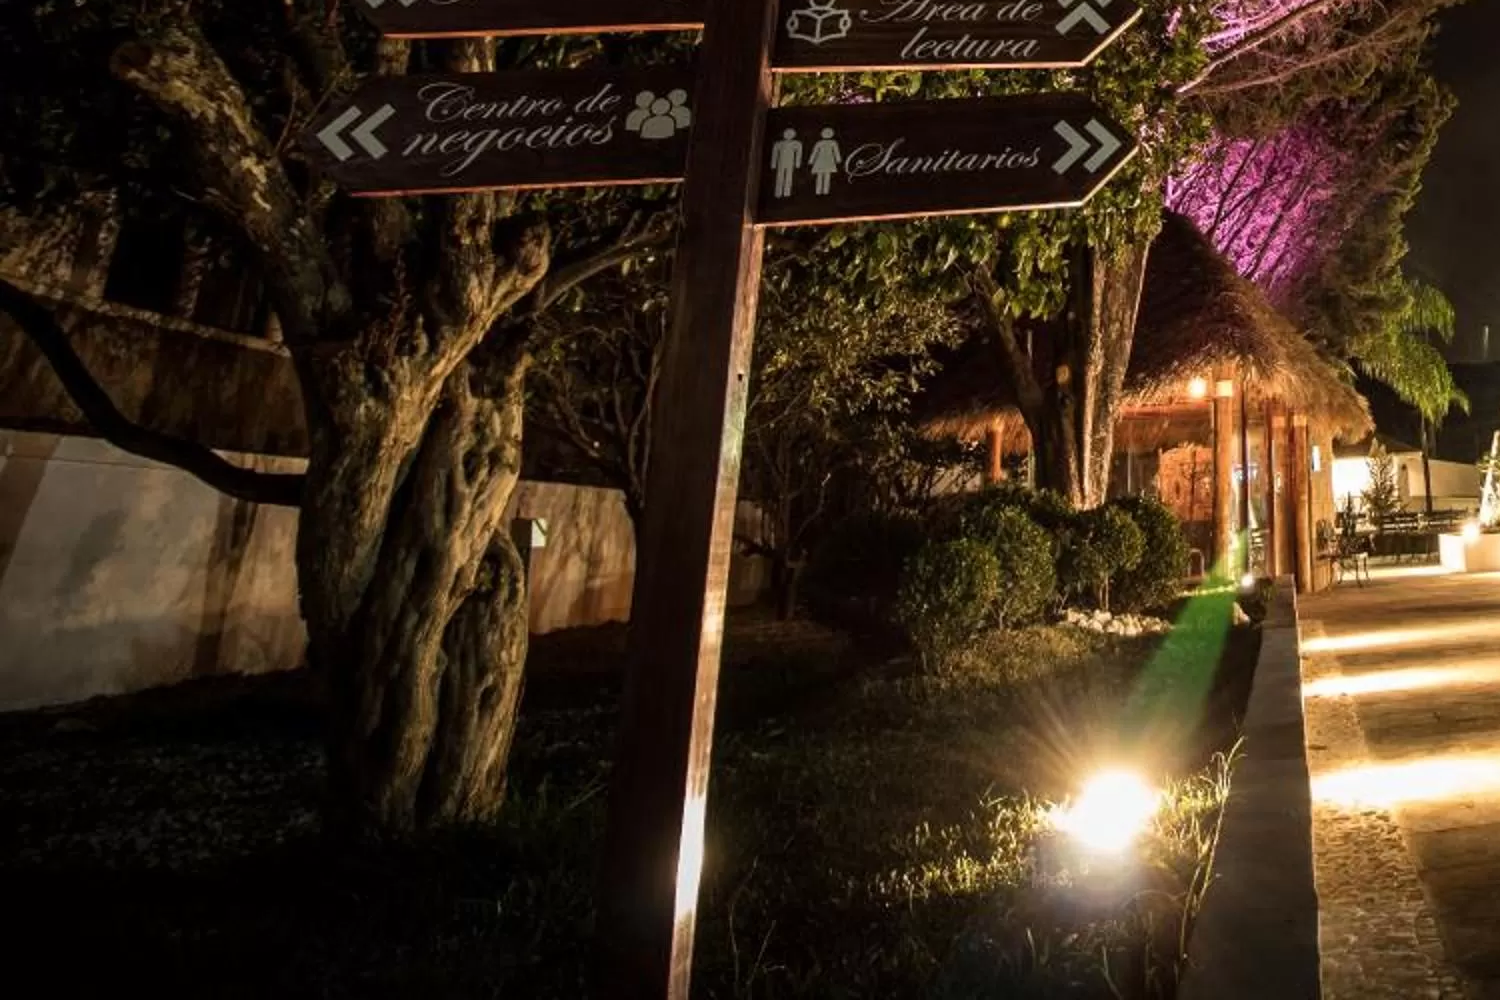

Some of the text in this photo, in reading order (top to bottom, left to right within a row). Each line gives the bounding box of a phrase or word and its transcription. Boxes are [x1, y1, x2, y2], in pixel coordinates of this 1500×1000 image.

[900, 26, 1041, 61] lectura
[417, 81, 622, 122] Centro de
[402, 114, 618, 178] negocios
[845, 137, 1041, 184] Sanitarios
